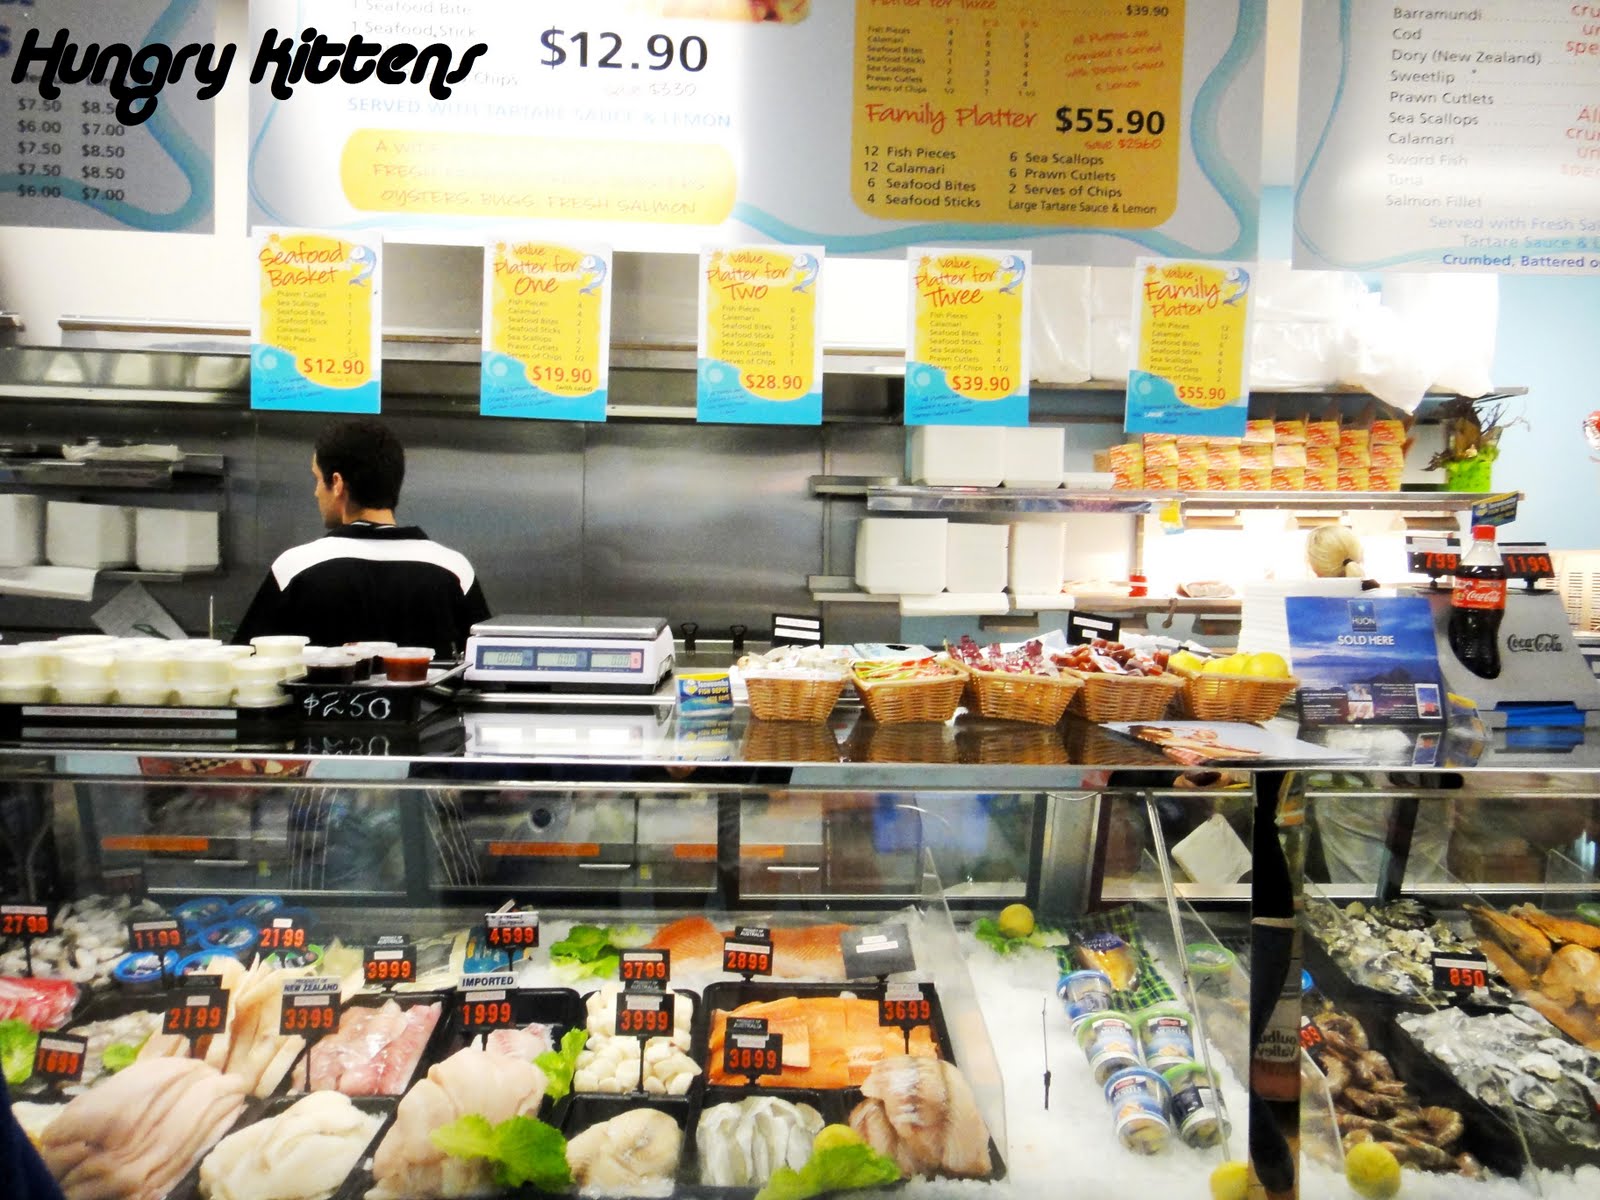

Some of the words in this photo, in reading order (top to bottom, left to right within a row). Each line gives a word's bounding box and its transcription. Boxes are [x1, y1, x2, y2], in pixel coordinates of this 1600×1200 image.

[1125, 4, 1169, 16] $39.90
[1393, 8, 1482, 21] Barramundi
[1392, 28, 1422, 40] Cod
[540, 26, 708, 72] $12.90
[1391, 49, 1427, 64] Dory
[1432, 49, 1471, 63] (New
[1476, 51, 1542, 66] Zealand)
[1390, 70, 1455, 84] Sweetlip
[17, 98, 62, 112] $7.50
[1390, 91, 1437, 104] Prawn
[1442, 92, 1494, 105] Cutlets
[865, 102, 948, 134] Family
[955, 105, 1037, 128] Platter
[1056, 106, 1165, 135] $55.90
[1389, 112, 1414, 124] Sea
[1420, 112, 1479, 127] Scallops
[17, 120, 62, 134] $6.00
[81, 123, 125, 137] $7.00
[1388, 132, 1454, 145] Calamari
[17, 141, 62, 155] $7.50
[81, 144, 125, 158] $8.50
[864, 146, 878, 156] 12
[887, 146, 913, 158] Fish
[917, 148, 956, 161] Pieces
[1009, 152, 1018, 161] 6
[1025, 152, 1047, 163] Sea
[1050, 152, 1104, 166] Scallops
[1387, 153, 1435, 166] Sword
[1440, 154, 1468, 167] Fish
[17, 163, 62, 177] $7.50
[81, 166, 125, 180] $8.50
[864, 162, 878, 172] 12
[887, 162, 945, 174] Calamari
[1009, 168, 1017, 178] 6
[1025, 168, 1066, 180] Prawn
[1070, 170, 1116, 182] Cutlets
[17, 184, 62, 198] $6.00
[867, 178, 875, 188] 6
[886, 178, 941, 191] Seafood
[945, 180, 976, 193] Bites
[1008, 184, 1016, 194] 2
[1024, 185, 1064, 197] Serves
[1068, 185, 1083, 197] of
[1087, 186, 1122, 199] Chips
[81, 187, 125, 201] $7.00
[867, 194, 875, 204] 4
[885, 194, 941, 207] Seafood
[944, 195, 981, 208] Sticks
[1386, 194, 1441, 208] Salmon
[1446, 196, 1482, 208] Fillet
[1008, 200, 1038, 213] Large
[1041, 201, 1077, 213] Tartare
[1079, 202, 1109, 213] Sauce
[1112, 204, 1119, 213] &
[1122, 204, 1157, 214] Lemon
[258, 241, 344, 267] Seafood
[1442, 254, 1515, 268] Crumbed,
[1521, 255, 1585, 268] Battered
[554, 255, 577, 273] for
[764, 263, 790, 280] for
[267, 265, 338, 288] Basket
[971, 266, 996, 283] for
[514, 276, 559, 296] One
[1144, 276, 1221, 309] Family
[924, 287, 984, 308] Three
[1152, 303, 1205, 318] Platter
[304, 357, 365, 375] $12.90
[533, 366, 592, 384] $19.90
[746, 374, 803, 390] $28.90
[952, 376, 1011, 392] $39.90
[1178, 385, 1226, 400] $55.90
[1507, 555, 1549, 572] 1199
[1337, 635, 1368, 646] SOLD
[1369, 635, 1395, 646] HERE
[135, 929, 181, 949] 1199
[490, 927, 534, 945] 4599
[727, 952, 768, 970] 2899
[367, 961, 412, 979] 3999
[623, 962, 666, 979] 3799
[1450, 968, 1485, 987] 850
[303, 984, 338, 992] ZEALAND
[462, 976, 514, 987] IMPORTED
[462, 1002, 512, 1025] 1999
[884, 1000, 931, 1020] 3699
[168, 1007, 222, 1030] 2199
[284, 1008, 335, 1029] 3399
[620, 1010, 669, 1031] 3999
